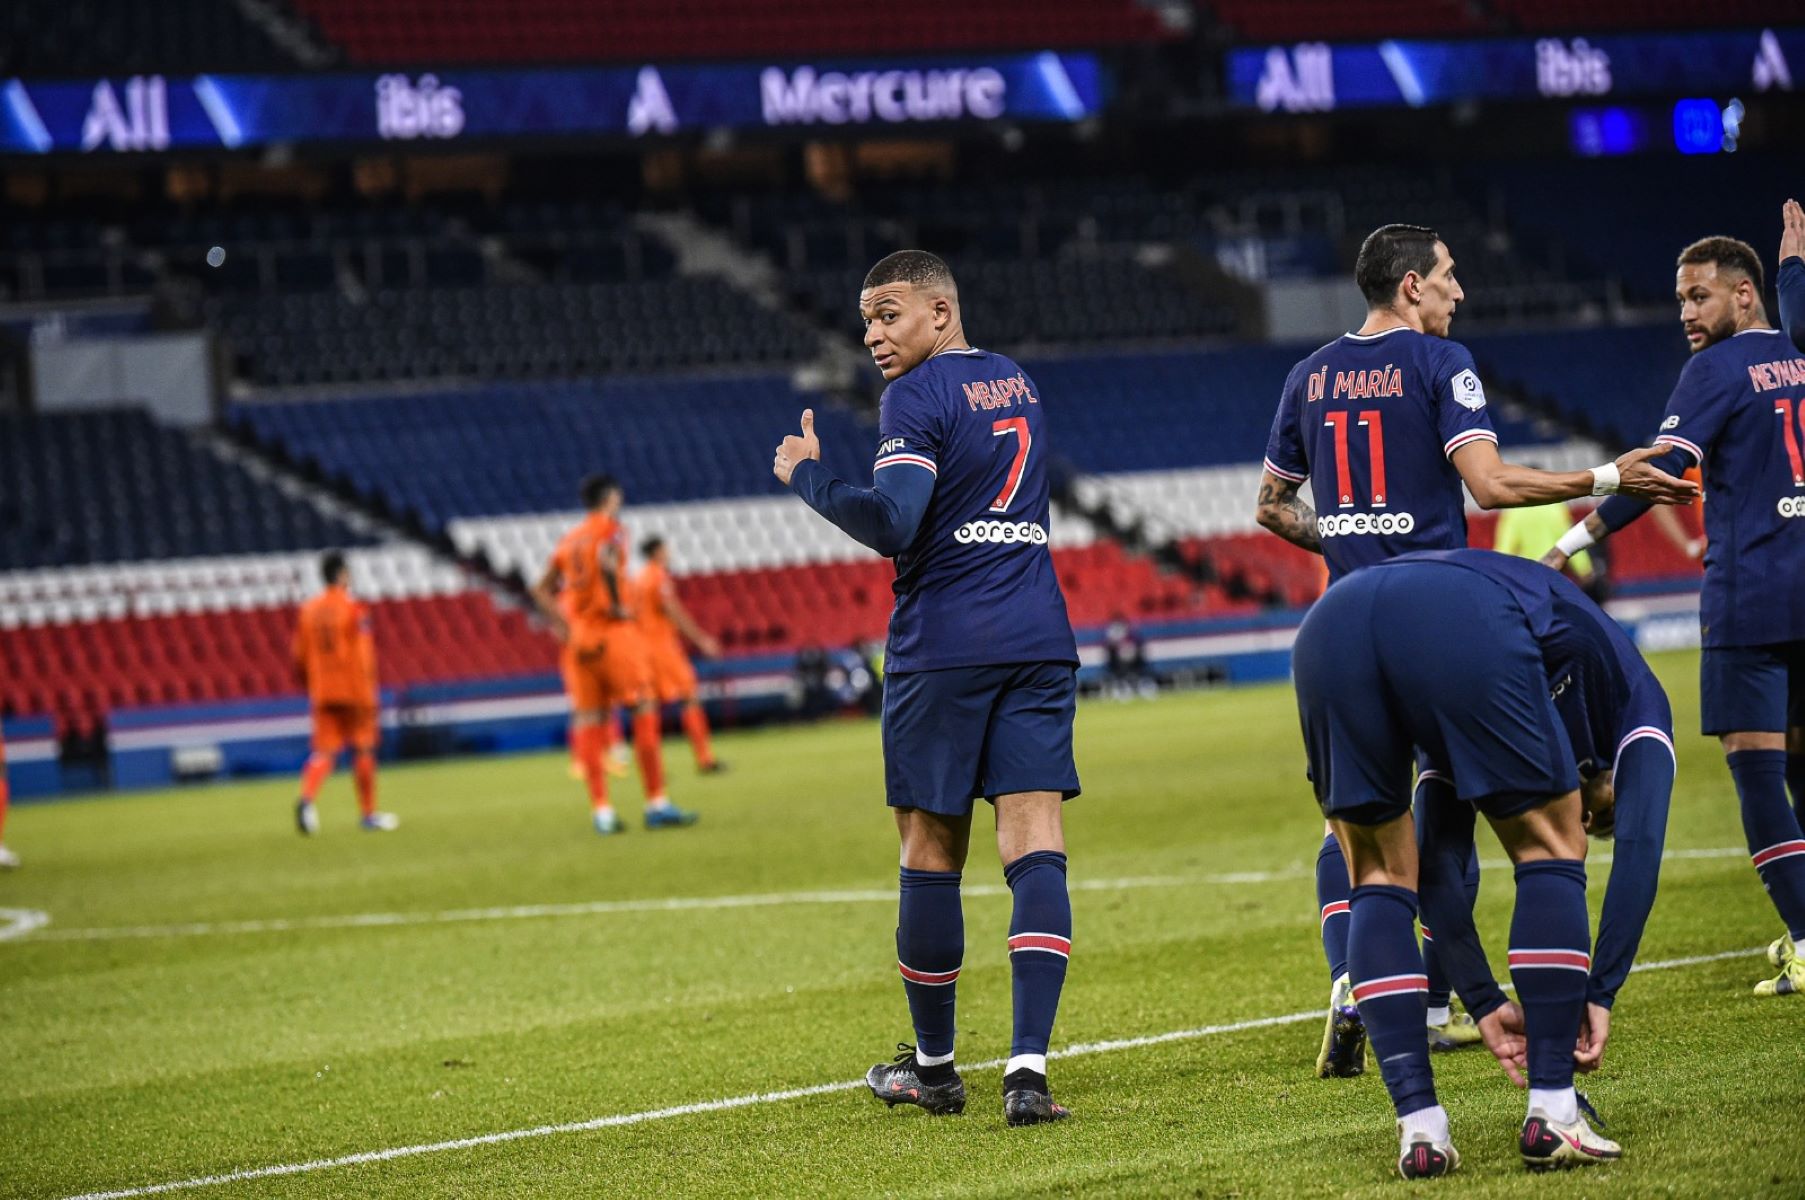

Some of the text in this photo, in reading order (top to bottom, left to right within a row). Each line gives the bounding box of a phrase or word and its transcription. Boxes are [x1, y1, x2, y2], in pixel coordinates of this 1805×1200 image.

[760, 65, 1006, 125] Mercure
[1535, 38, 1611, 96] ibis
[376, 73, 466, 139] ibis
[1333, 364, 1403, 400] MARÍA
[989, 416, 1031, 512] 7
[1324, 410, 1387, 508] 11
